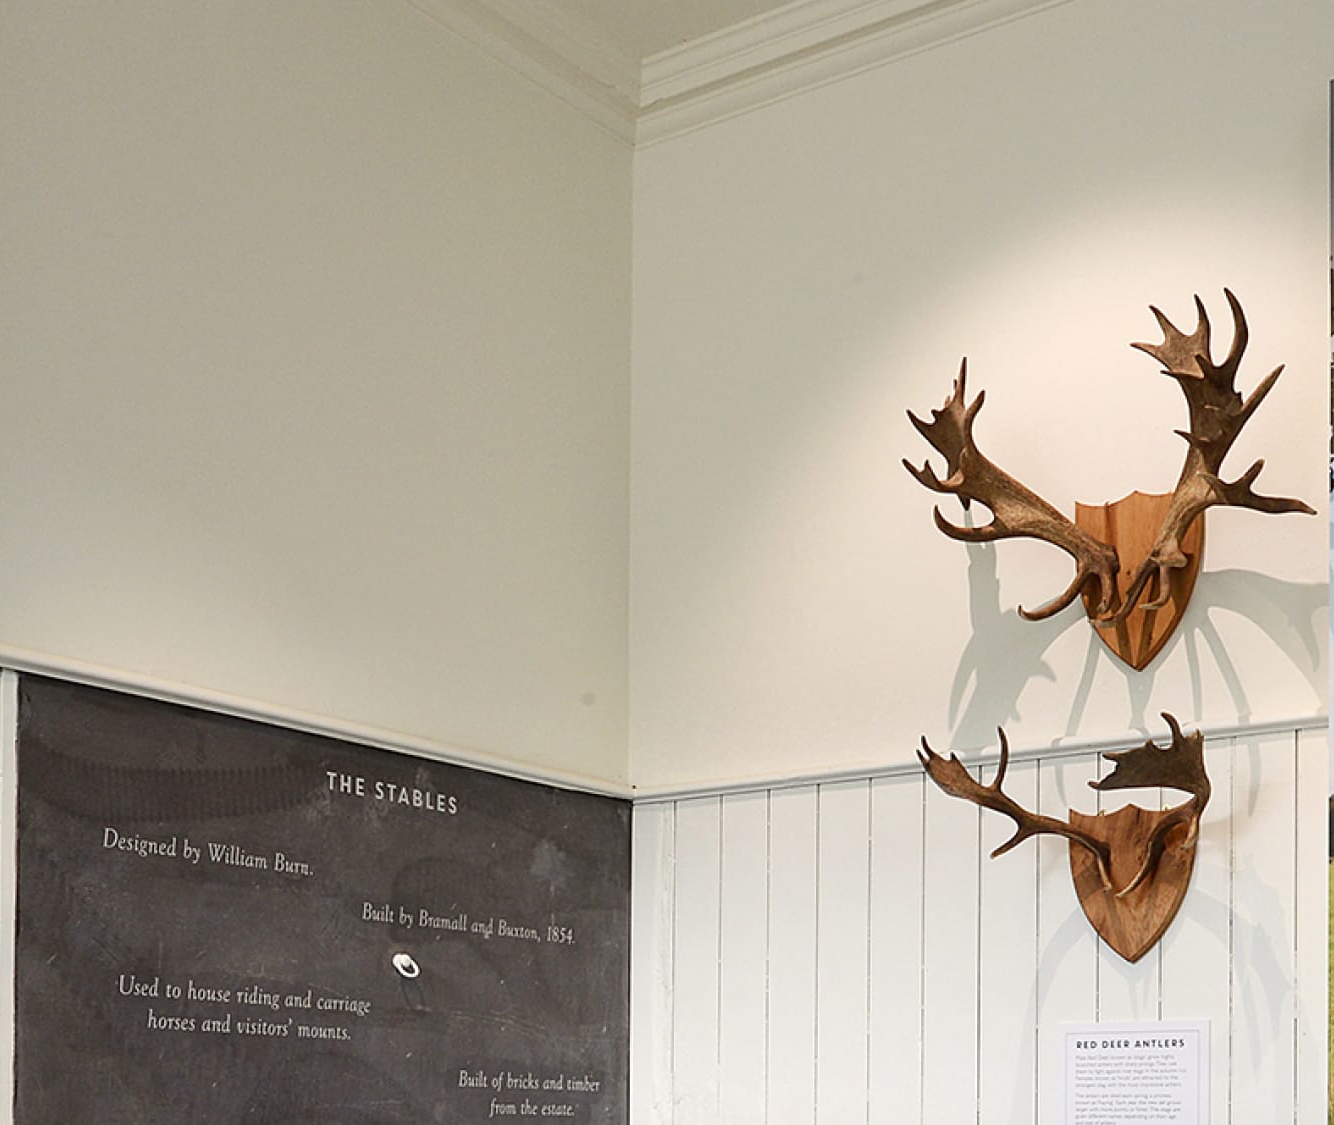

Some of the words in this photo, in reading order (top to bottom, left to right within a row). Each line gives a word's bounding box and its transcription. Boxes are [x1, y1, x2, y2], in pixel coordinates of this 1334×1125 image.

[326, 771, 365, 797] THE
[374, 781, 457, 815] STABLES
[103, 827, 177, 857] Designed
[183, 839, 201, 864] by
[207, 842, 268, 870] William
[274, 852, 314, 876] Burn.
[362, 902, 394, 923] Built
[399, 906, 413, 929] by
[419, 909, 467, 932] Bramall
[470, 917, 494, 939] and
[498, 919, 541, 943] Buxton,
[119, 974, 159, 997] Used
[166, 984, 182, 999] to
[187, 980, 231, 1003] house
[236, 985, 280, 1010] riding
[284, 989, 312, 1008] and
[317, 996, 371, 1017] carriage
[148, 1008, 196, 1031] horses
[201, 1013, 231, 1033] and
[297, 1025, 351, 1040] mounts.
[1076, 1040, 1098, 1049] RED
[1101, 1039, 1130, 1049] DEER
[1134, 1039, 1185, 1048] ANTLERS
[458, 1069, 487, 1088] Built
[491, 1071, 504, 1092] of
[507, 1071, 539, 1090] bricks
[542, 1074, 564, 1091] and
[567, 1075, 600, 1092] timber
[489, 1097, 517, 1118] from
[520, 1098, 538, 1116] the
